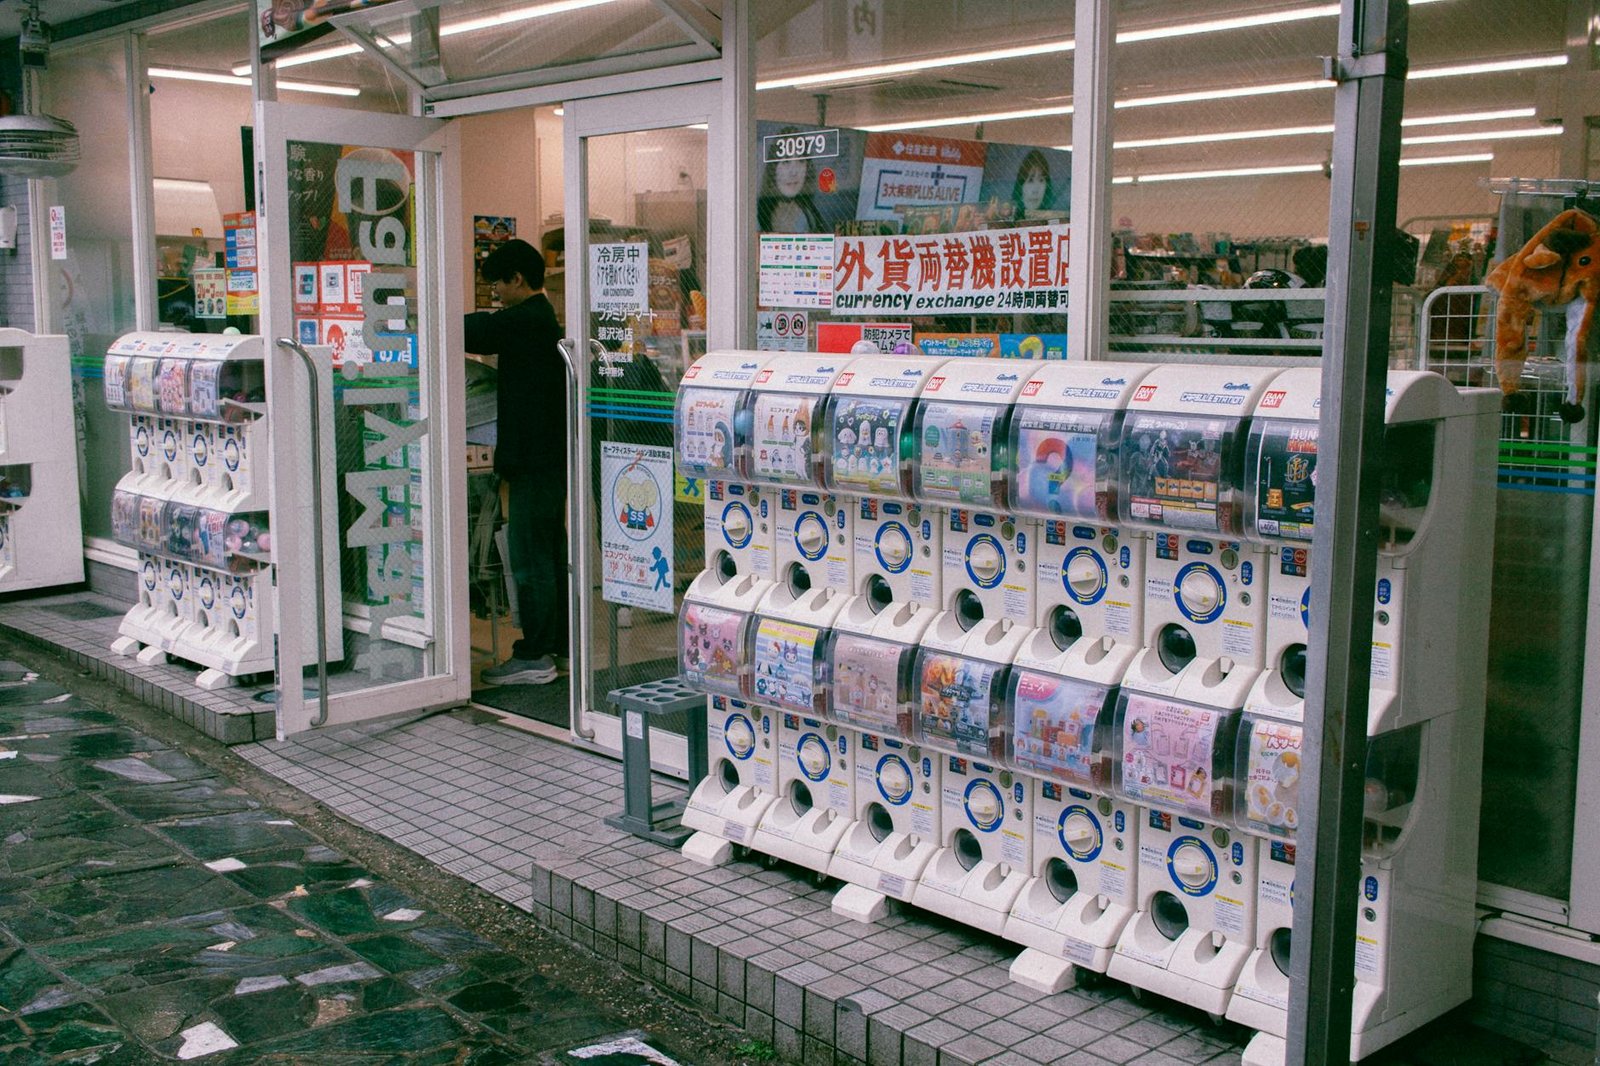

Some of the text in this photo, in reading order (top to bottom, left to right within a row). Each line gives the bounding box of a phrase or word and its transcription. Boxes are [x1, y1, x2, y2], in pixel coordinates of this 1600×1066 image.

[776, 135, 826, 157] 30979
[597, 246, 640, 264] 冷房中
[836, 292, 913, 312] currency
[916, 292, 995, 310] exchange
[598, 308, 657, 322] ファミリーマート
[864, 328, 911, 341] 防犯カメラで
[1265, 392, 1285, 400] BAN
[630, 511, 645, 522] SS
